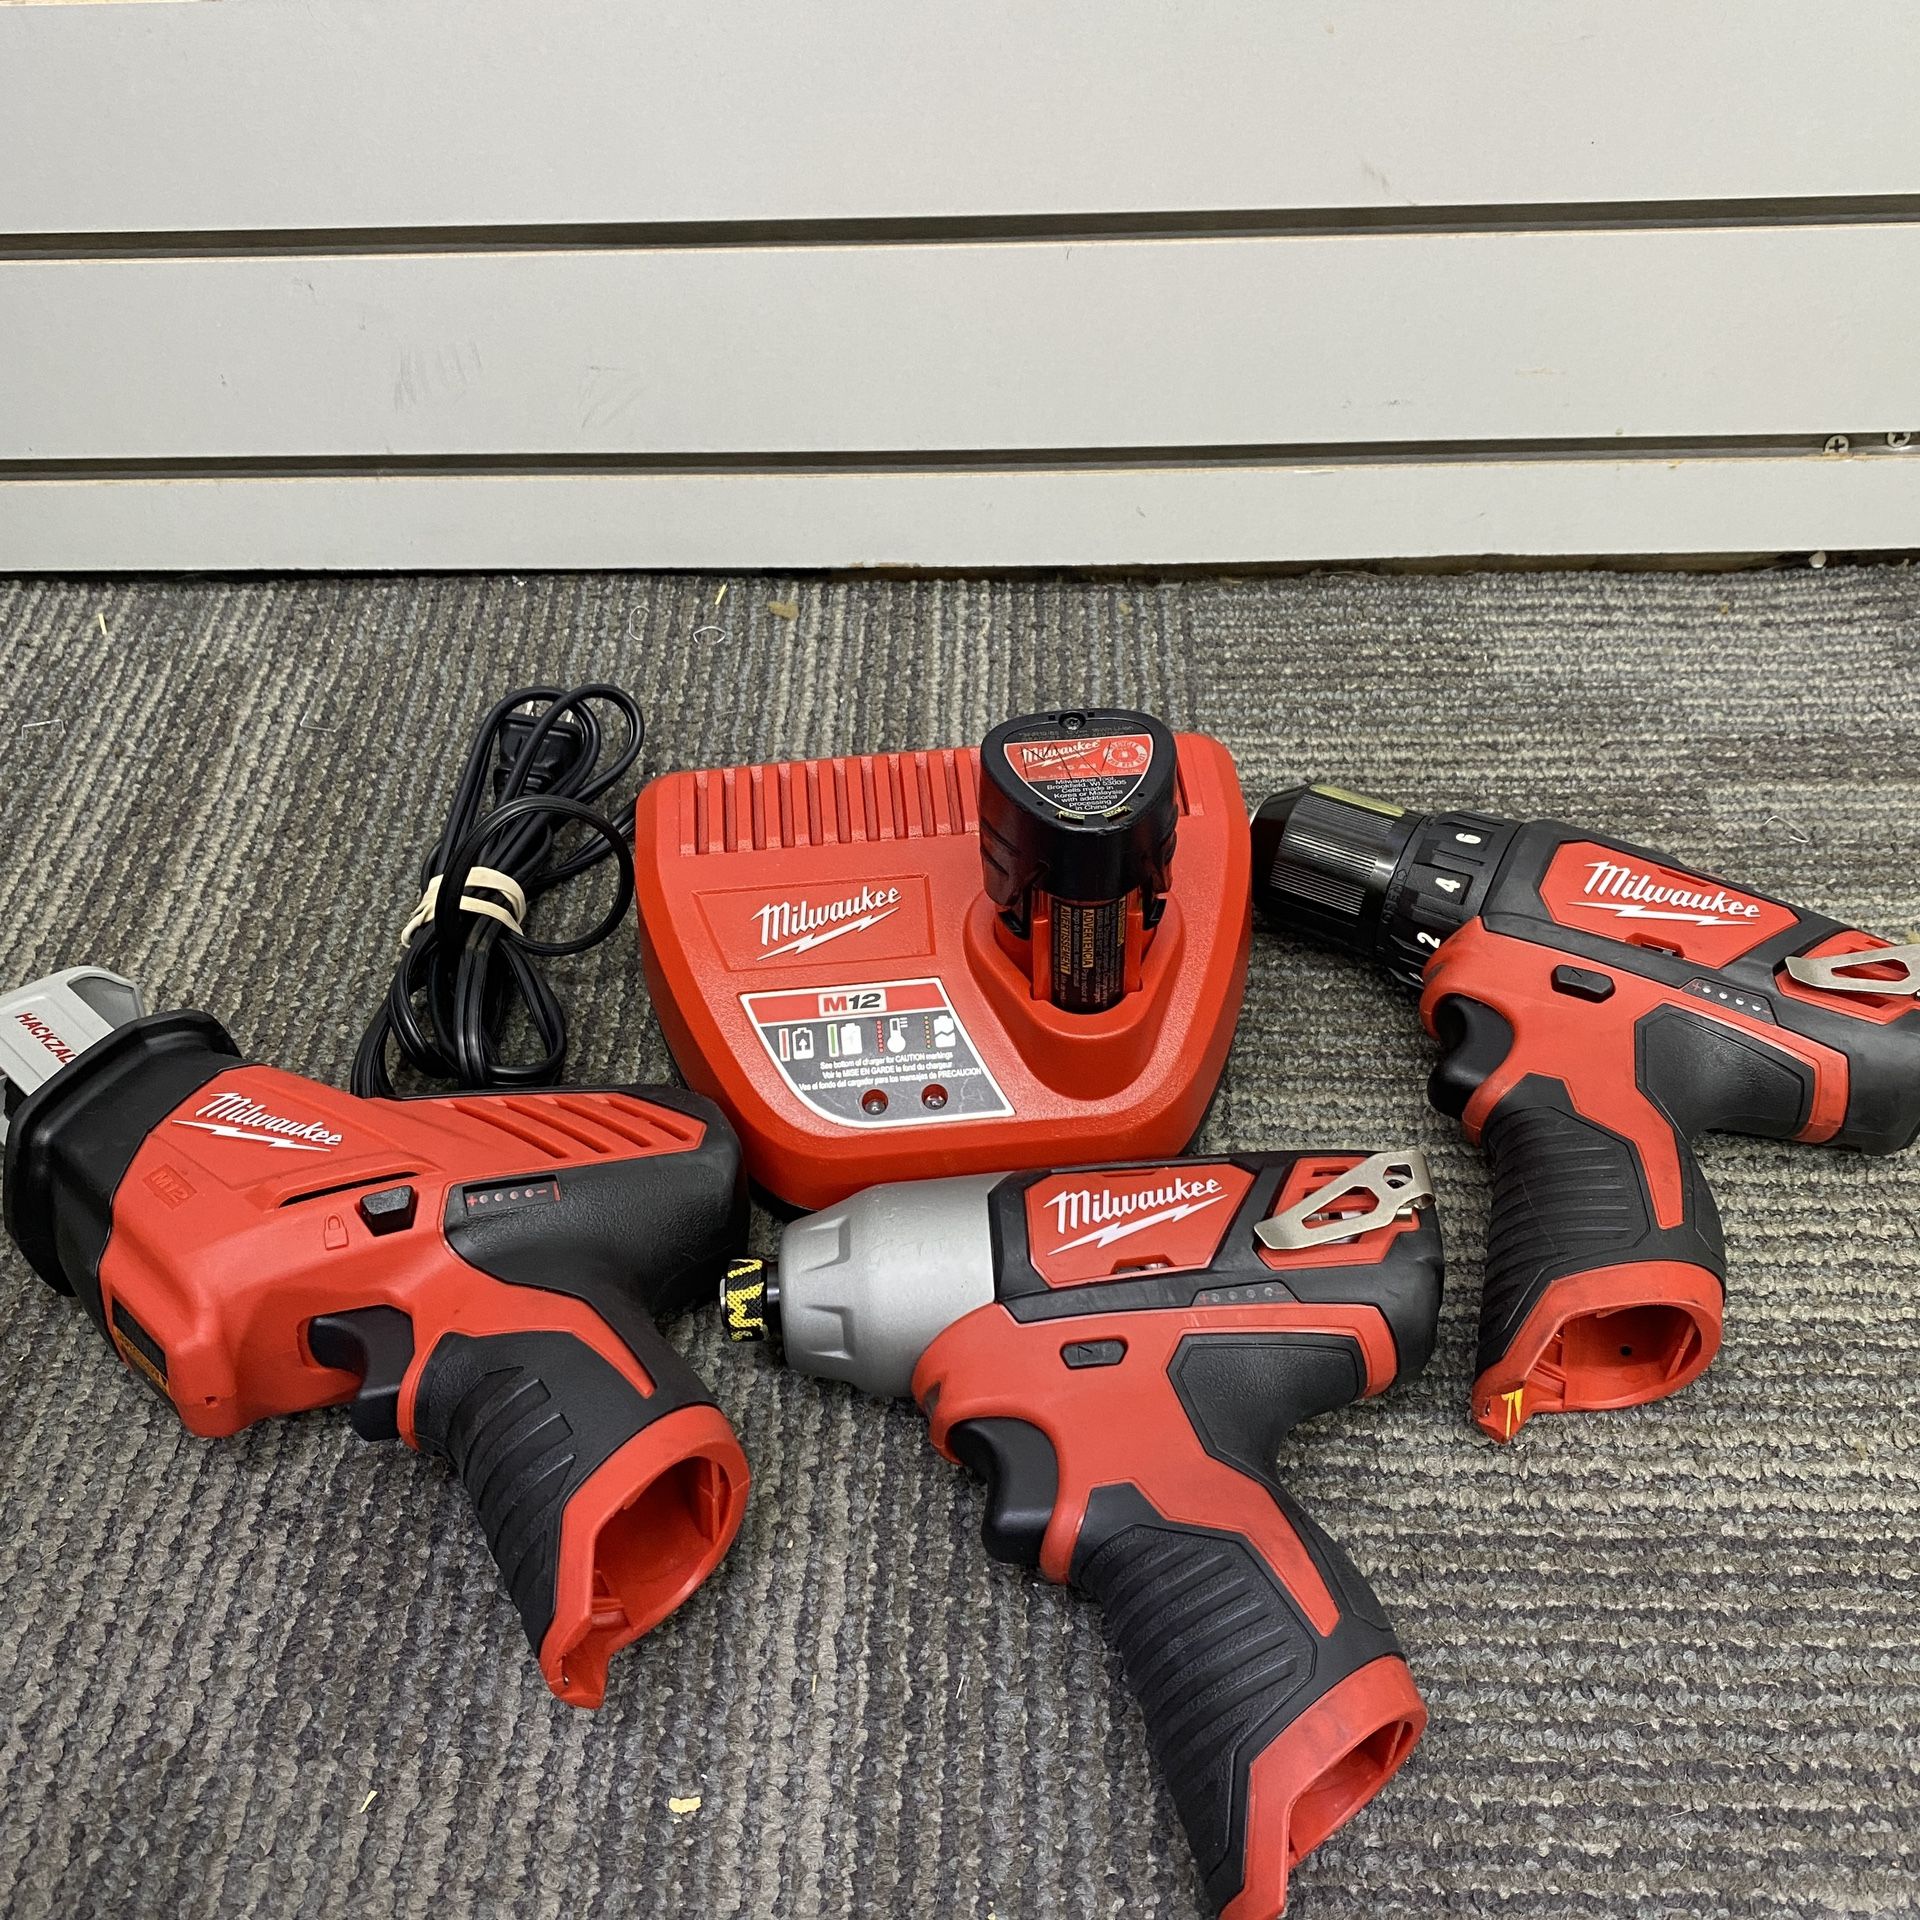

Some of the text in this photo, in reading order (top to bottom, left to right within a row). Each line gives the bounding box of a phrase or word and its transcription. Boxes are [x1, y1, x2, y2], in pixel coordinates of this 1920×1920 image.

[1017, 740, 1101, 764] Milwaukee
[1069, 799, 1112, 808] processing
[1088, 789, 1123, 797] Malaysia
[1455, 832, 1482, 845] 6
[1435, 877, 1461, 893] 4
[1583, 860, 1761, 918] Milwaukee
[750, 885, 902, 947] Milwaukee
[1061, 908, 1071, 973] AVERTISSEMENT
[1083, 910, 1094, 967] ADVERTENCIA
[1417, 931, 1441, 949] 2
[823, 992, 882, 1013] M12
[15, 1012, 78, 1067] HACKZAL
[820, 1051, 953, 1070] See bottom of charger for CAUTION markings
[822, 1071, 835, 1079] Voir
[842, 1068, 860, 1077] MISE
[860, 1067, 870, 1076] EN
[871, 1065, 895, 1074] GARDE
[902, 1064, 916, 1072] fond
[926, 1061, 953, 1070] chargeur
[799, 1083, 811, 1091] Vea
[812, 1081, 818, 1090] el
[819, 1081, 836, 1089] fondo
[837, 1079, 847, 1087] del
[847, 1078, 874, 1088] cargador
[874, 1077, 889, 1085] para
[889, 1075, 899, 1083] los
[899, 1073, 928, 1082] mensajes
[928, 1072, 937, 1080] de
[195, 1092, 343, 1146] Milwaukee
[150, 1170, 190, 1204] M12
[1043, 1177, 1223, 1235] Milwaukee
